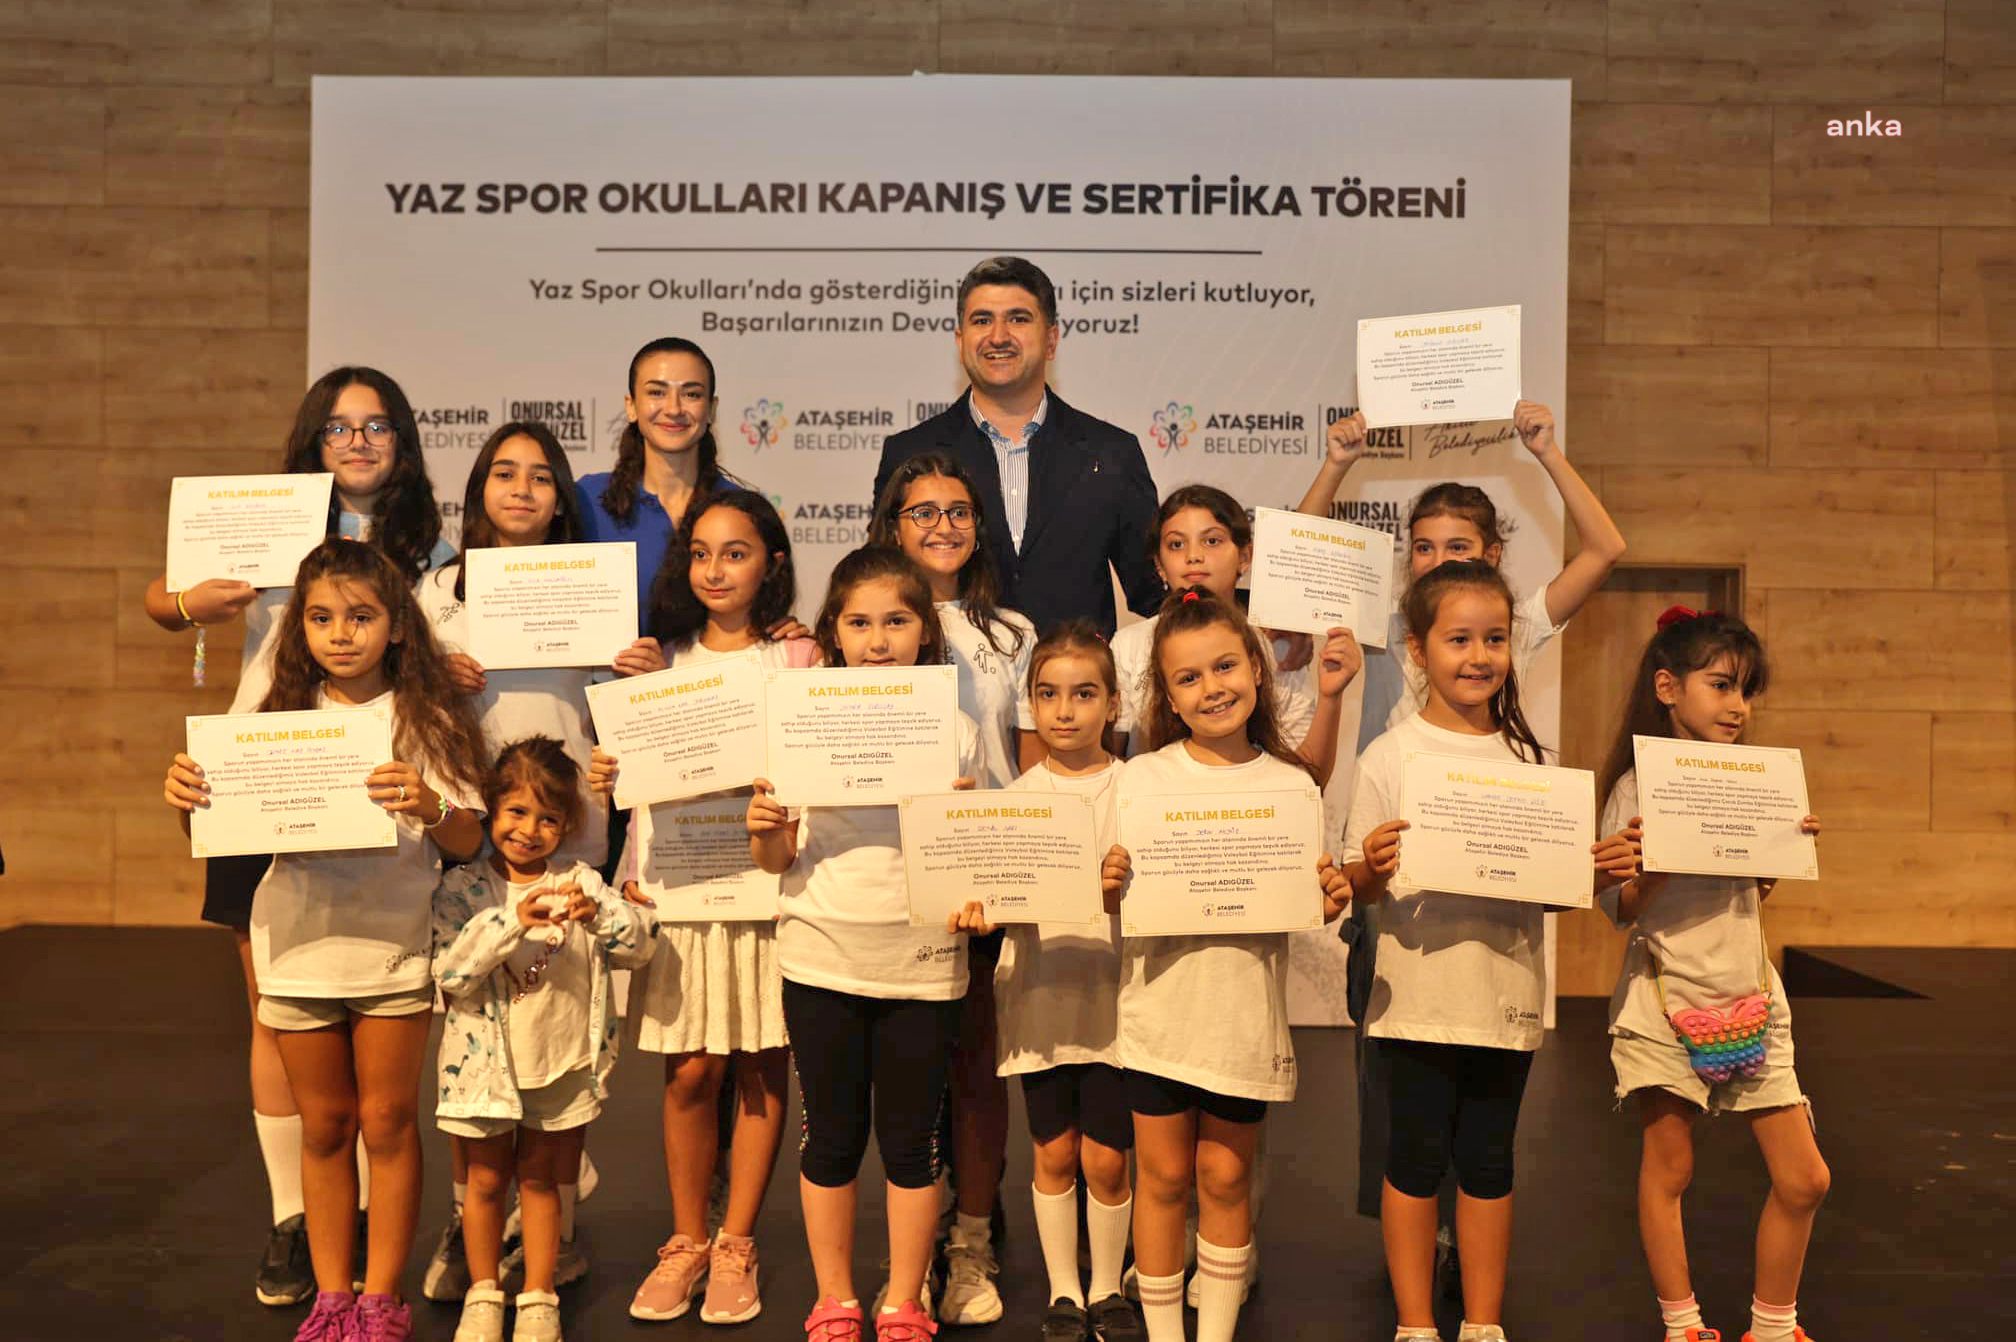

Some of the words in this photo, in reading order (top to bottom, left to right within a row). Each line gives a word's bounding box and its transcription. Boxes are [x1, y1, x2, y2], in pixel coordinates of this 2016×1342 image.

[386, 183, 465, 213] YAZ
[476, 182, 587, 214] SPOR
[598, 182, 807, 214] OKULLARI
[818, 182, 1005, 220] KAPANIŞ
[1015, 183, 1071, 214] VE
[1082, 175, 1301, 216] SERTİFİKA
[1311, 177, 1466, 218] TÖRENİ
[529, 280, 573, 299] Yaz
[582, 279, 640, 304] Spor
[648, 279, 801, 300] Okulları'nda
[810, 279, 961, 304] gösterdiğini
[1072, 280, 1113, 305] için
[1122, 281, 1196, 302] sizleri
[1204, 282, 1316, 308] kutluyor,
[702, 312, 883, 336] Başarılarınızın
[893, 313, 956, 332] Deva
[1395, 327, 1436, 338] KATILIM
[1439, 322, 1481, 335] BELGESİ
[511, 401, 585, 420] ONURSAL
[796, 406, 893, 430] ATAŞEHİR
[1205, 411, 1304, 434] ATAŞEHİR
[794, 432, 882, 450] BELEDİYE
[1204, 435, 1308, 455] BELEDİYESİ
[208, 490, 248, 499] KATILIM
[250, 487, 294, 497] BELGESİ
[795, 503, 874, 524] ATAŞEH
[793, 525, 867, 543] BELEDİY
[1291, 529, 1329, 542] KATILIM
[1331, 536, 1366, 550] BELGESİ
[505, 562, 548, 572] KATILIM
[550, 558, 595, 569] BELGESİ
[630, 687, 675, 705] KATILIM
[677, 674, 723, 694] BELGESİ
[809, 686, 858, 697] KATILIM
[862, 683, 912, 695] BELGESİ
[236, 731, 289, 743] KATILIM
[293, 726, 345, 740] BELGESİ
[1675, 758, 1719, 770] KATILIM
[1721, 761, 1765, 773] BELGESİ
[675, 815, 716, 825] KATILIM
[719, 814, 746, 824] BELG
[947, 809, 998, 819] KATILIM
[1001, 806, 1052, 818] BELGESİ
[1166, 810, 1218, 822] KATILIM
[1221, 806, 1275, 820] BELGESİ
[1466, 840, 1492, 849] Onursal
[1493, 842, 1528, 853] ADIGÜZEL
